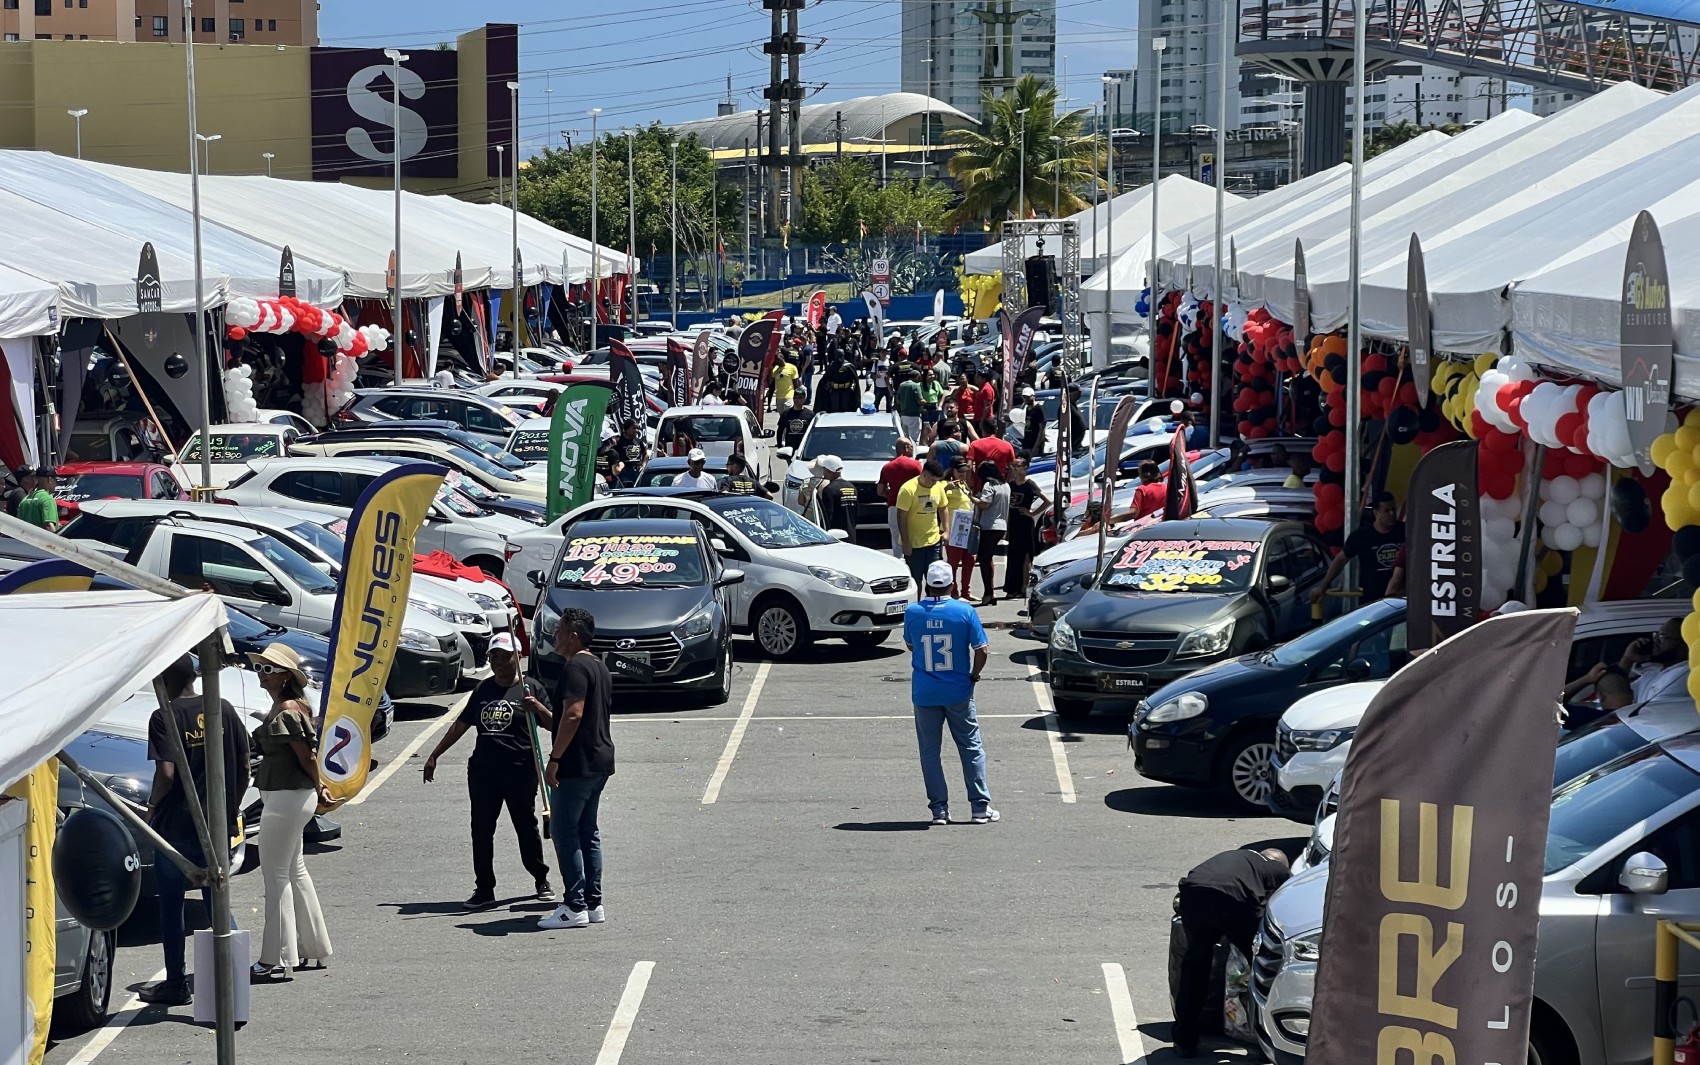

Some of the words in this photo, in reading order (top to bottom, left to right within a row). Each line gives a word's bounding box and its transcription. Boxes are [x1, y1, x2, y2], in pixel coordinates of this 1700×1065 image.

[677, 367, 685, 387] SENA
[737, 376, 759, 391] DOM
[677, 387, 686, 407] AUTO
[559, 398, 588, 501] INOVA
[570, 535, 698, 546] OPORTUNIDADE
[563, 544, 601, 562] 18
[600, 548, 680, 558] COMPLETO
[1431, 483, 1457, 617] ESTRELA
[594, 556, 660, 565] APENAS
[1113, 550, 1151, 569] 11
[1150, 551, 1209, 562] AGILE
[1144, 559, 1226, 569] COMPLETO
[920, 633, 954, 672] 13
[1115, 679, 1144, 687] ESTRELA
[481, 710, 512, 721] DUELO
